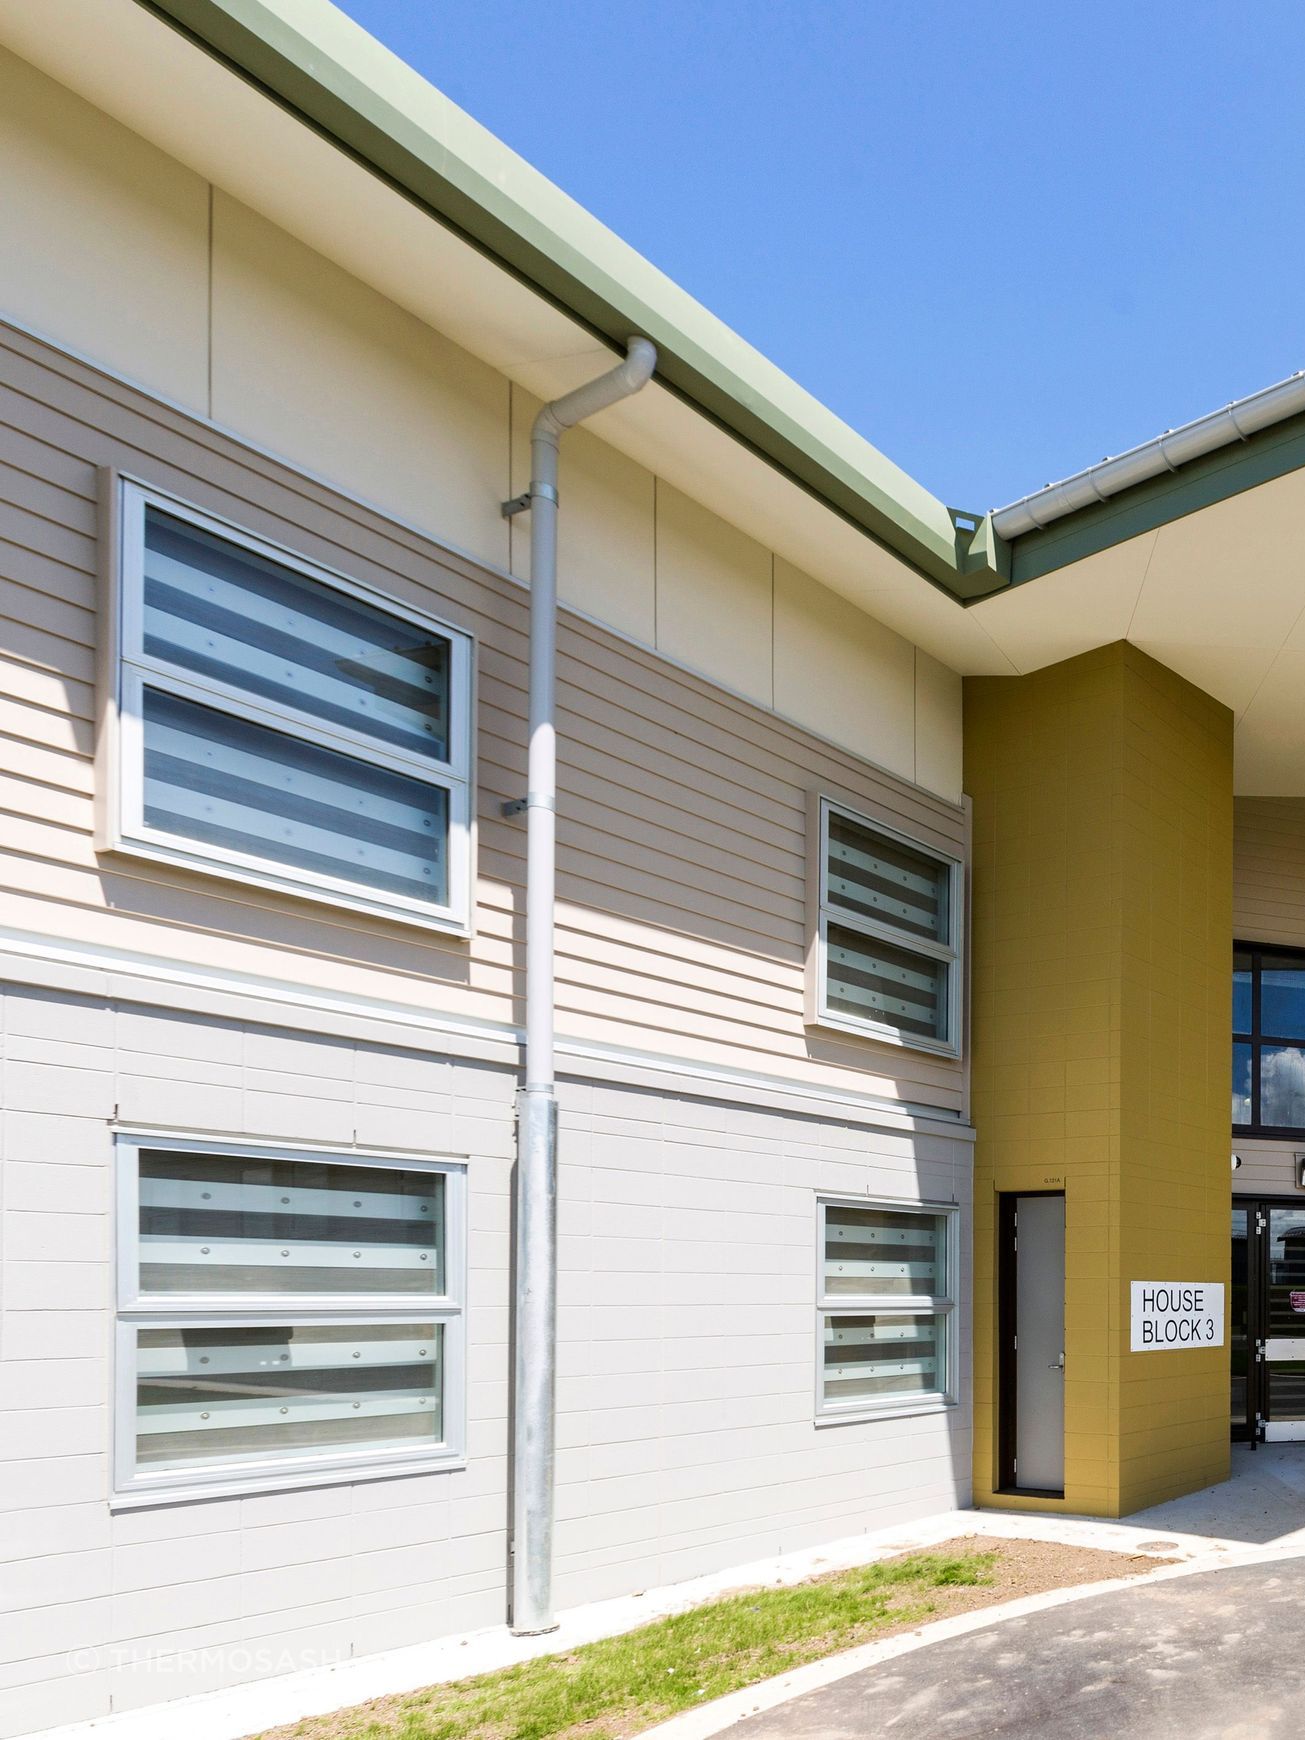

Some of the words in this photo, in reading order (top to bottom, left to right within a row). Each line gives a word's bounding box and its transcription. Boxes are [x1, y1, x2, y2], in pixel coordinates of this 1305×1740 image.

[1142, 1289, 1204, 1312] HOUSE
[1142, 1319, 1201, 1343] BLOCK
[1205, 1318, 1214, 1340] 3
